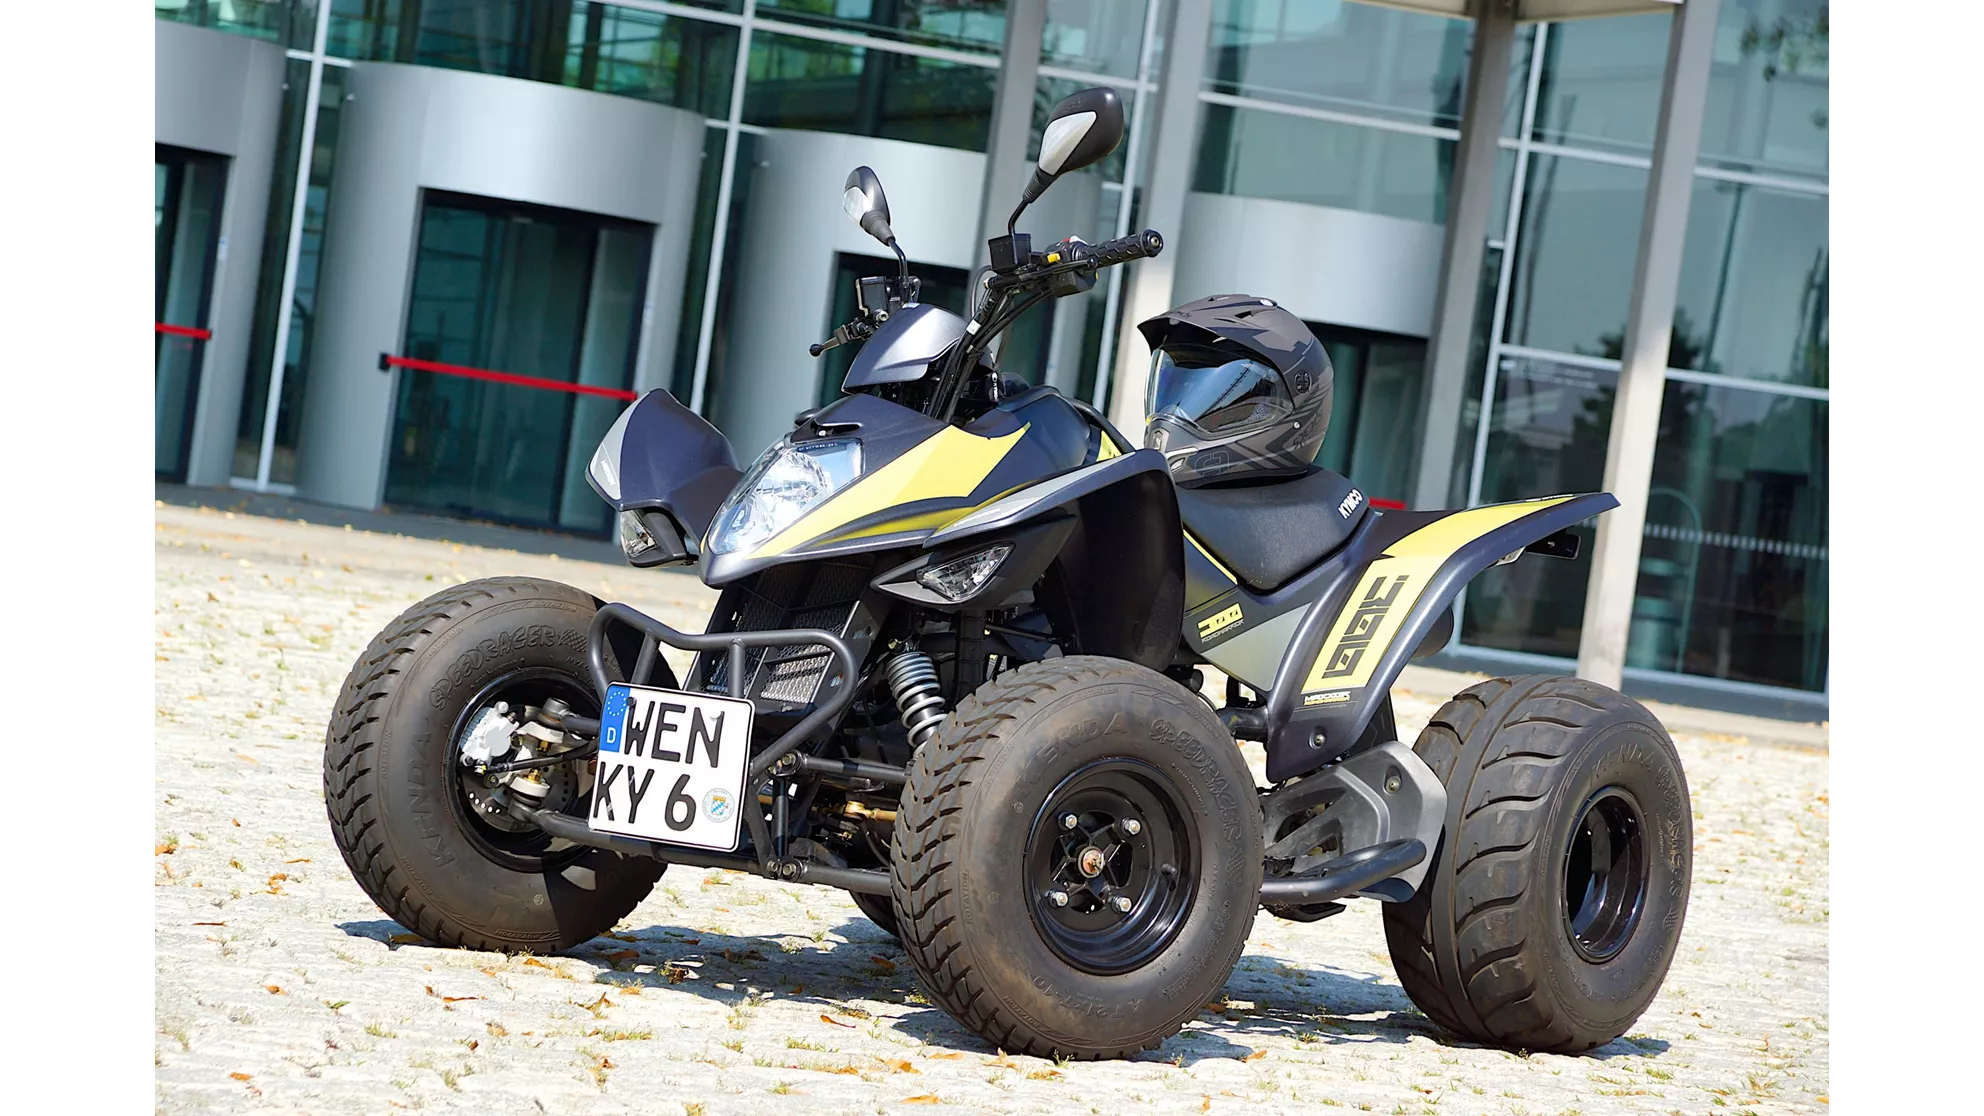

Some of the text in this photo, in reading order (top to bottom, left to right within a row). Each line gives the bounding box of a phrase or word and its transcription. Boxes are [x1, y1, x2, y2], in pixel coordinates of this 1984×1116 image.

[1337, 488, 1363, 520] KYMCO
[1197, 602, 1244, 638] 300
[429, 624, 556, 711] SPEEDRACER
[606, 726, 617, 744] D
[624, 697, 725, 768] WEN
[407, 732, 457, 868] KENDA
[592, 761, 655, 824] KY
[664, 773, 697, 832] 6
[1148, 718, 1243, 842] SPEEDRACER
